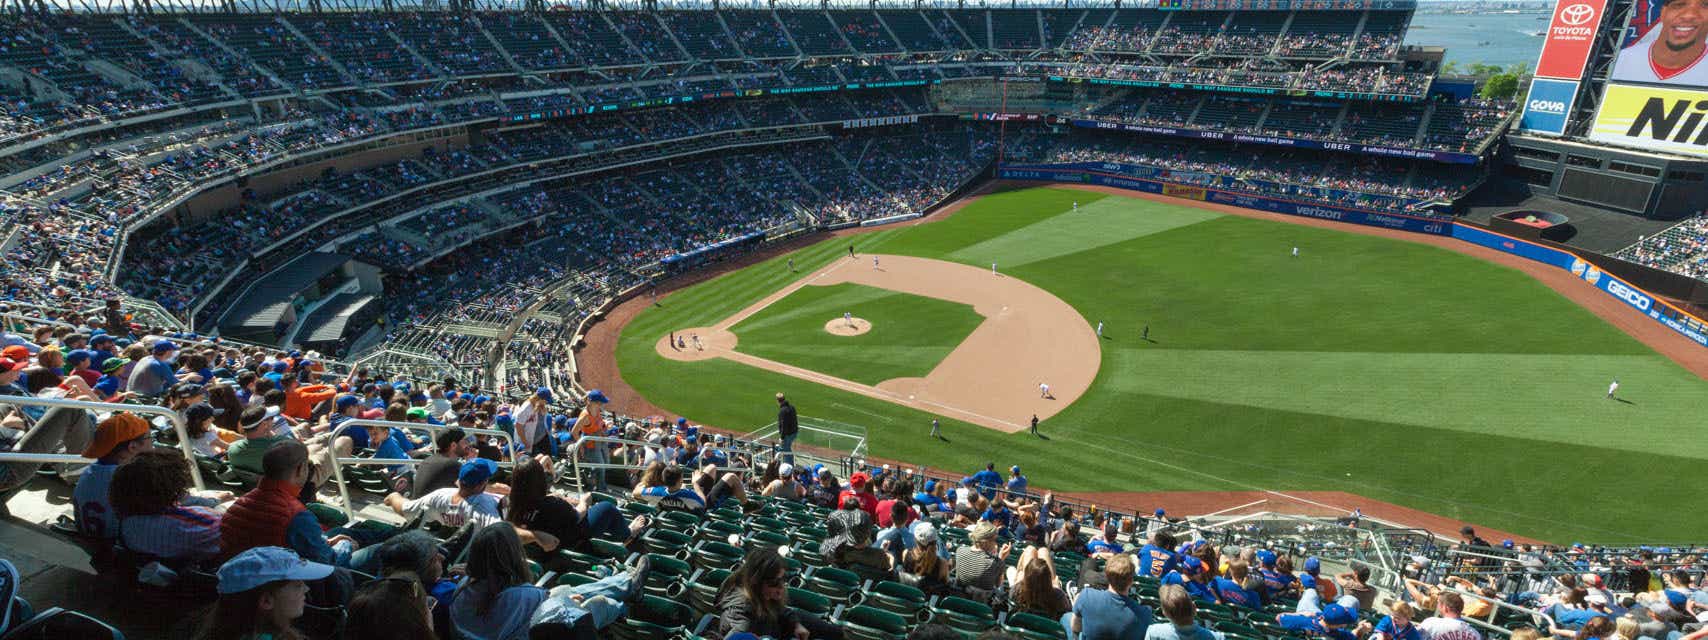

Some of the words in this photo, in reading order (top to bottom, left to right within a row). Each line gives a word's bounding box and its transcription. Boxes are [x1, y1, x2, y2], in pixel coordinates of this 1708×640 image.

[1552, 26, 1591, 36] TOYOTA
[1529, 98, 1566, 112] GOYA
[1324, 142, 1351, 151] UBER
[1416, 151, 1436, 159] game
[1296, 205, 1342, 220] verizon
[1423, 224, 1442, 233] citi
[1608, 279, 1650, 310] GEICO
